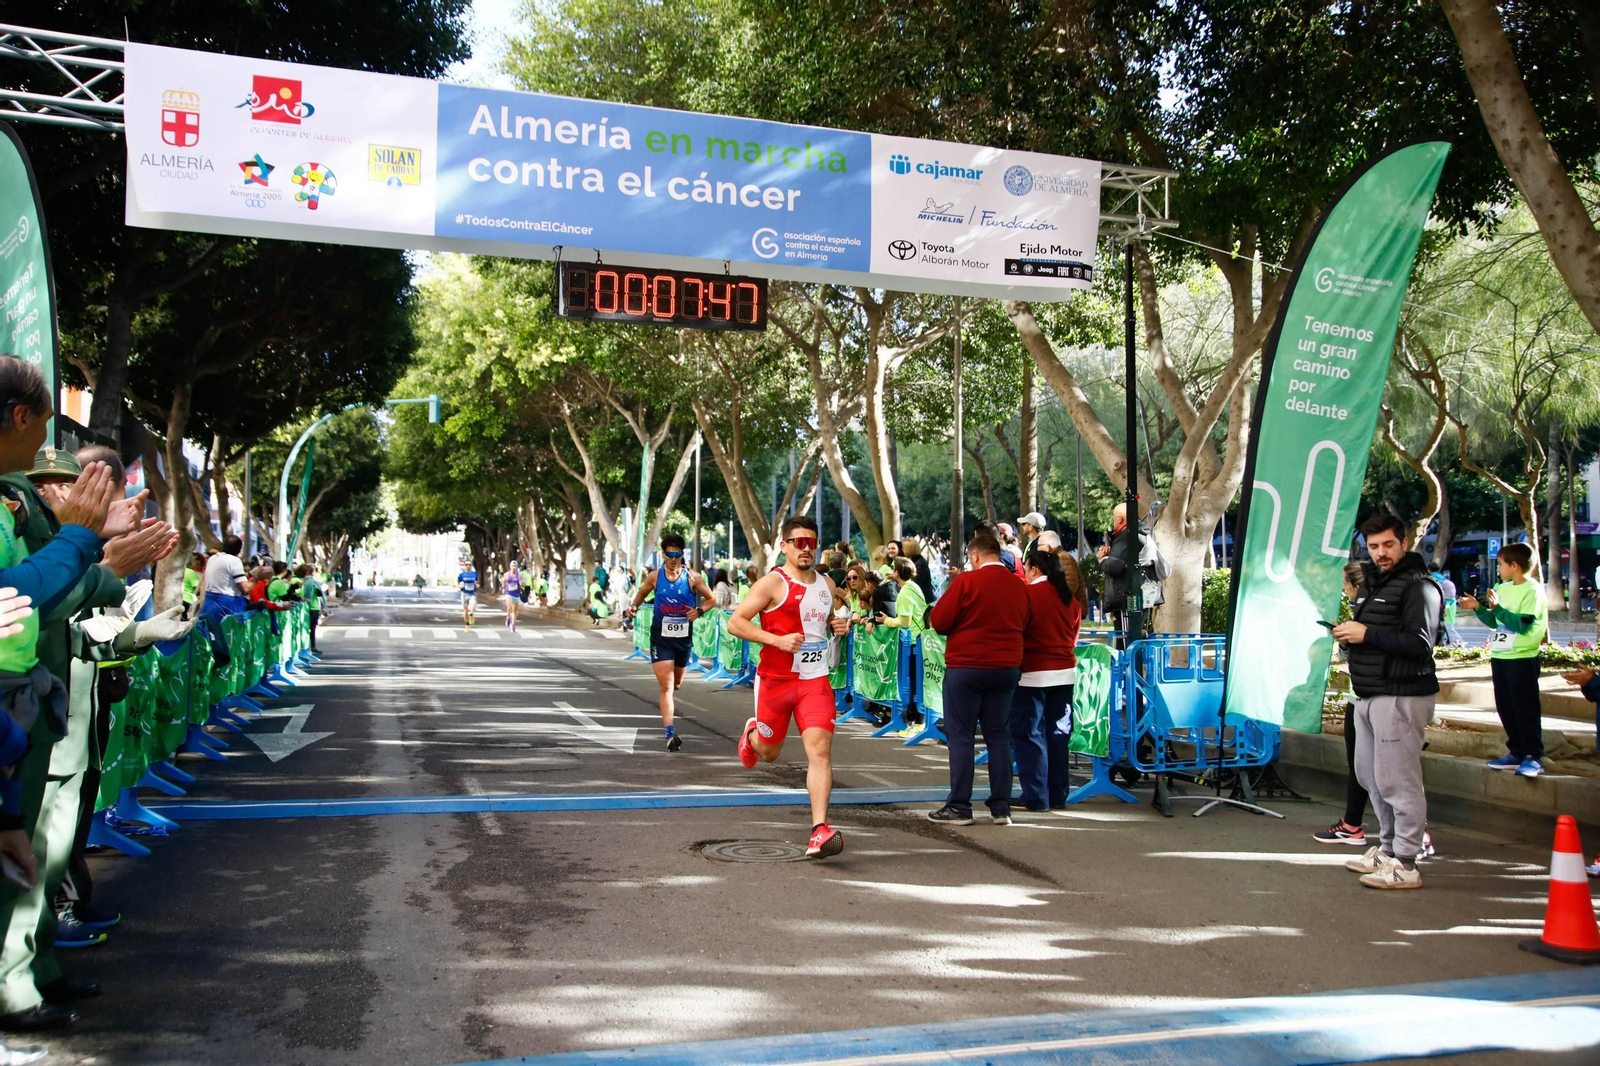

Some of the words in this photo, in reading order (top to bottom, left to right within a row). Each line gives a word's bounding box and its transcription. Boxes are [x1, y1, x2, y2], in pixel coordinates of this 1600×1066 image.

[468, 104, 632, 151] Almería
[645, 130, 692, 156] en
[706, 136, 847, 174] marcha
[140, 153, 214, 171] ALMERÍA
[159, 169, 199, 180] CIUDAD
[387, 164, 415, 176] CABRAS
[915, 160, 984, 180] cajamar
[467, 157, 605, 193] contra
[617, 165, 656, 198] el
[667, 171, 801, 212] cáncer
[1033, 174, 1089, 189] UNIVERSIDAD
[1034, 182, 1049, 192] DE
[262, 192, 282, 201] 2005
[455, 213, 593, 236] #TodosContraElCáncer
[917, 213, 963, 224] MICHELIN
[980, 210, 1058, 231] Fundación
[784, 232, 826, 242] asociación
[827, 236, 861, 246] española
[785, 241, 810, 250] contra
[819, 244, 846, 254] cáncer
[921, 242, 955, 254] Toyota
[1020, 243, 1047, 257] Ejido
[1050, 244, 1083, 258] Motor
[796, 251, 828, 261] Almería
[921, 254, 959, 267] Alborán
[961, 259, 990, 270] Motor
[1037, 266, 1054, 274] Jeep
[1057, 266, 1070, 276] FIAT
[594, 270, 759, 324] 00:07:47
[1304, 315, 1374, 342] Tenemos
[1297, 338, 1316, 352] un
[1320, 343, 1357, 361] gran
[1293, 359, 1350, 380] camino
[1288, 378, 1316, 394] por
[1285, 396, 1348, 420] delante
[667, 623, 684, 632] 691
[801, 650, 823, 663] 225
